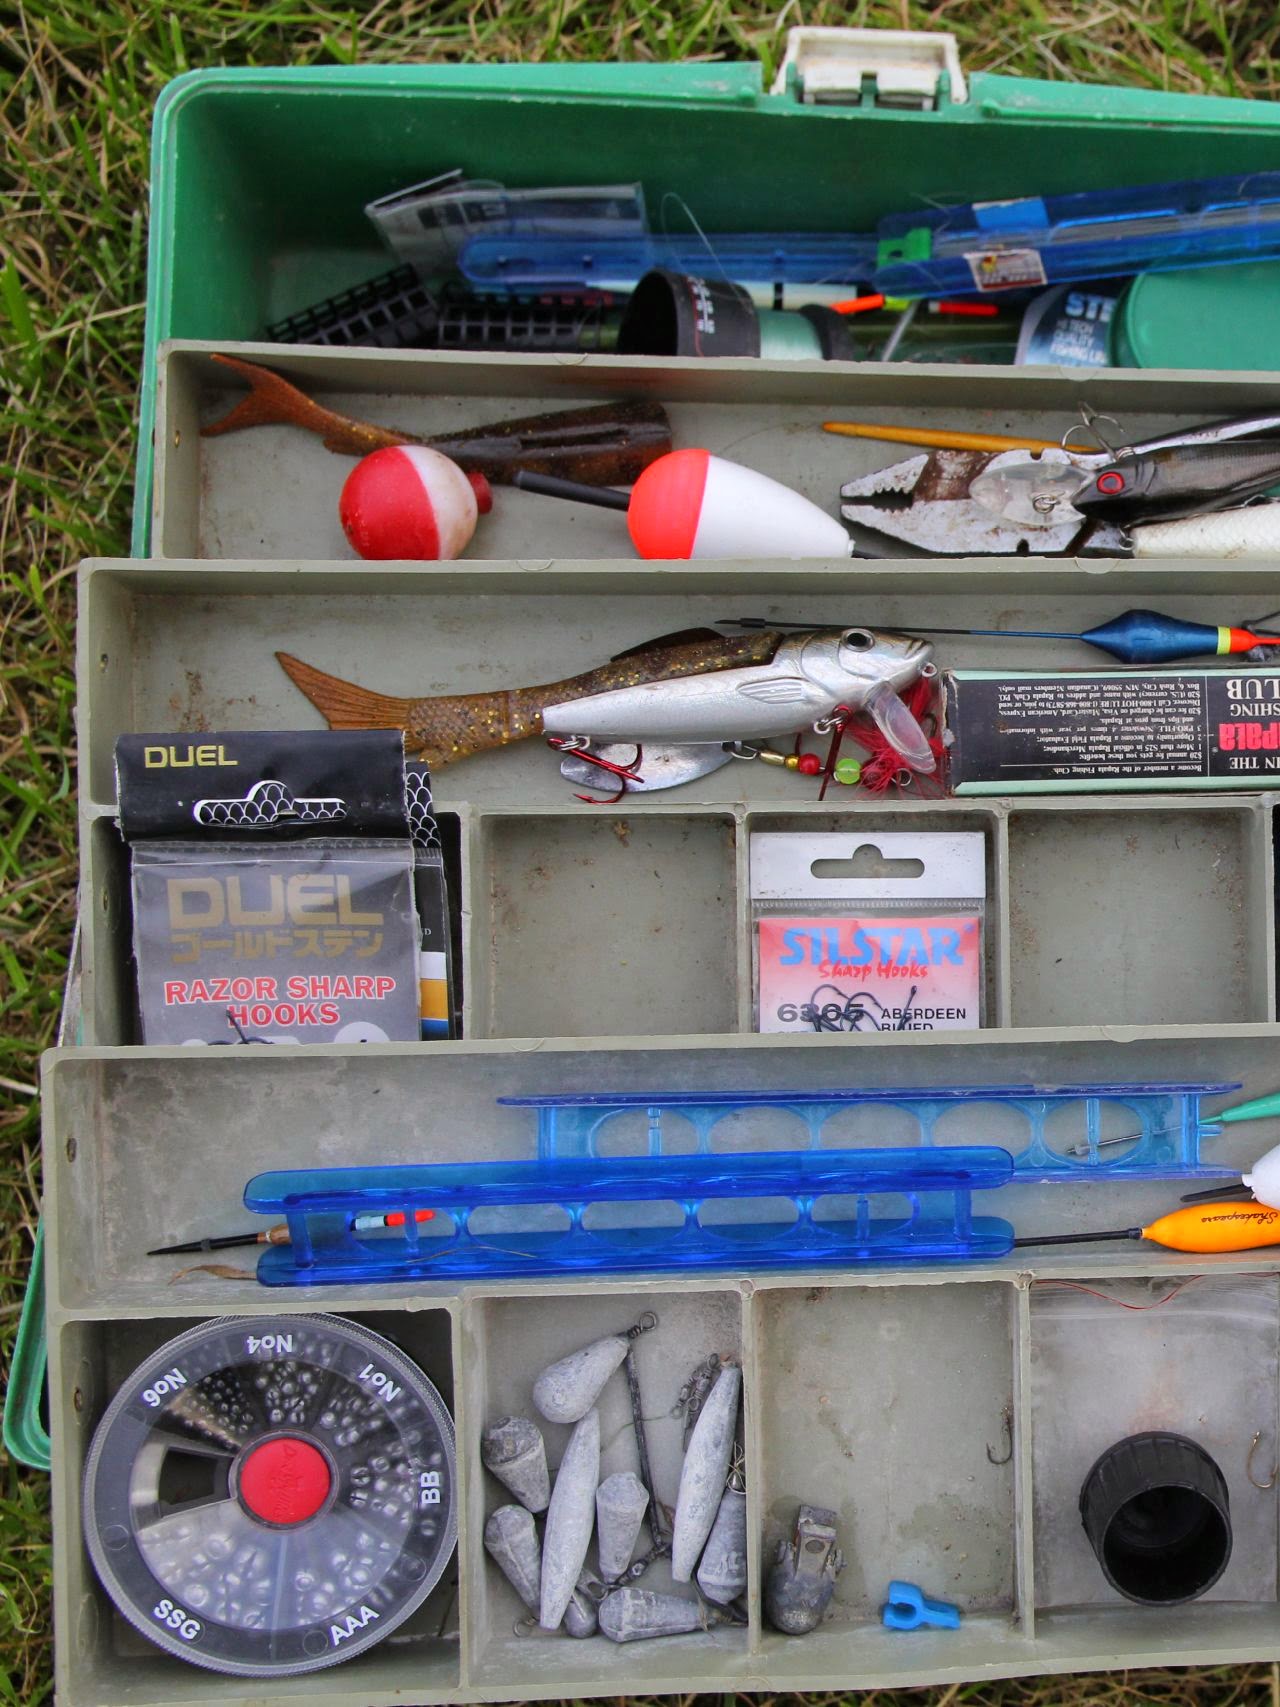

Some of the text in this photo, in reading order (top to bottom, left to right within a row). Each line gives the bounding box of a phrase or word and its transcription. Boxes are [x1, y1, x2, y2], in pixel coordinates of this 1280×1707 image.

[1130, 707, 1155, 715] charged
[144, 745, 238, 768] DUEL
[1140, 751, 1153, 759] gets
[1190, 751, 1202, 759] $20
[1229, 756, 1260, 769] THE
[1098, 765, 1120, 773] Rapala
[1177, 764, 1202, 772] Become
[167, 874, 384, 930] DUEL
[171, 929, 384, 964] ゴールドステン
[779, 926, 964, 967] SILSTAR
[818, 959, 928, 983] Sharp Hooks
[164, 975, 396, 1005] RAZOR SHARP
[228, 1002, 340, 1027] HOOKS
[881, 1008, 967, 1021] ABERDEEN
[1201, 1212, 1279, 1225] Shakespeare
[247, 1334, 293, 1354] No4
[143, 1368, 187, 1407] No6
[359, 1363, 401, 1402] No1
[420, 1470, 441, 1504] BB
[154, 1599, 201, 1640] SSG
[330, 1606, 379, 1647] AAA
